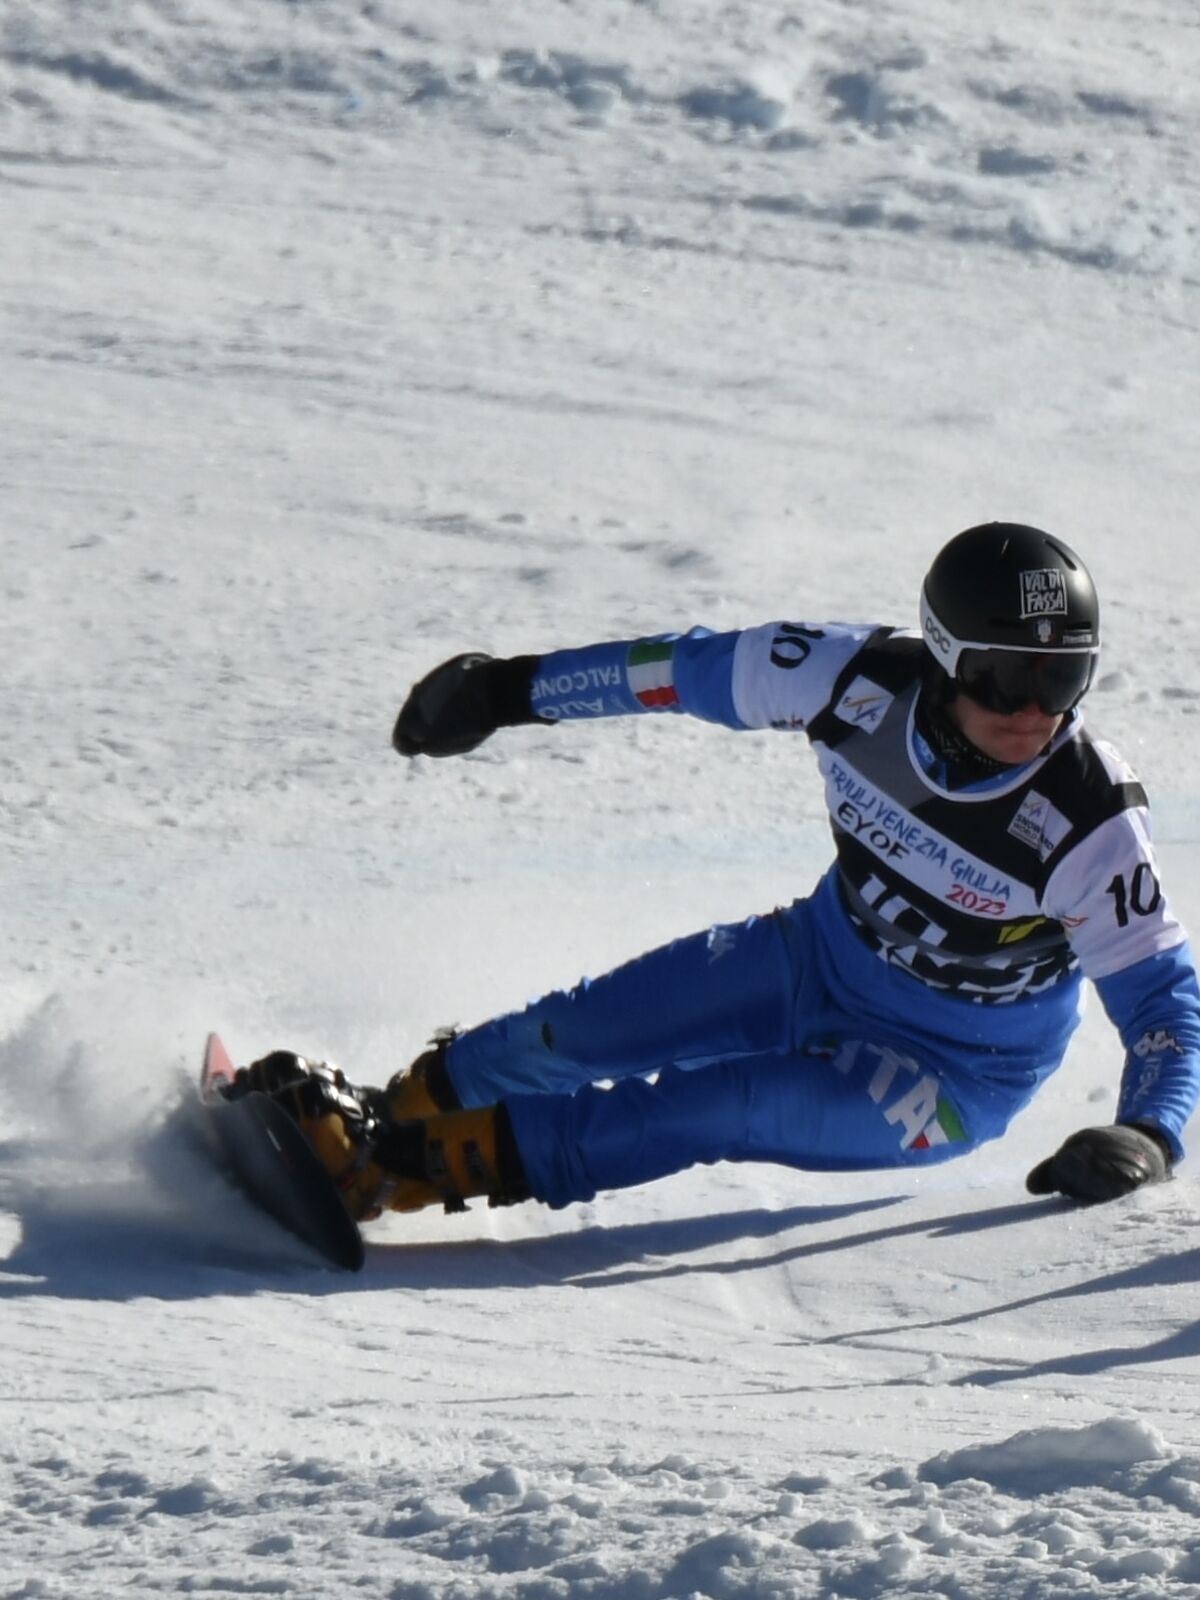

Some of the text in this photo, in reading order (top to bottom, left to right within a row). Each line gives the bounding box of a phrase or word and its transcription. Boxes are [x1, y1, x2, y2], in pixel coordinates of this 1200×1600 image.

[1026, 590, 1064, 613] FASSA
[829, 762, 1011, 900] FRIULI VENEZIA GIULIA
[837, 801, 910, 860] EYOF
[945, 883, 1007, 917] 2023
[1105, 861, 1161, 928] 10
